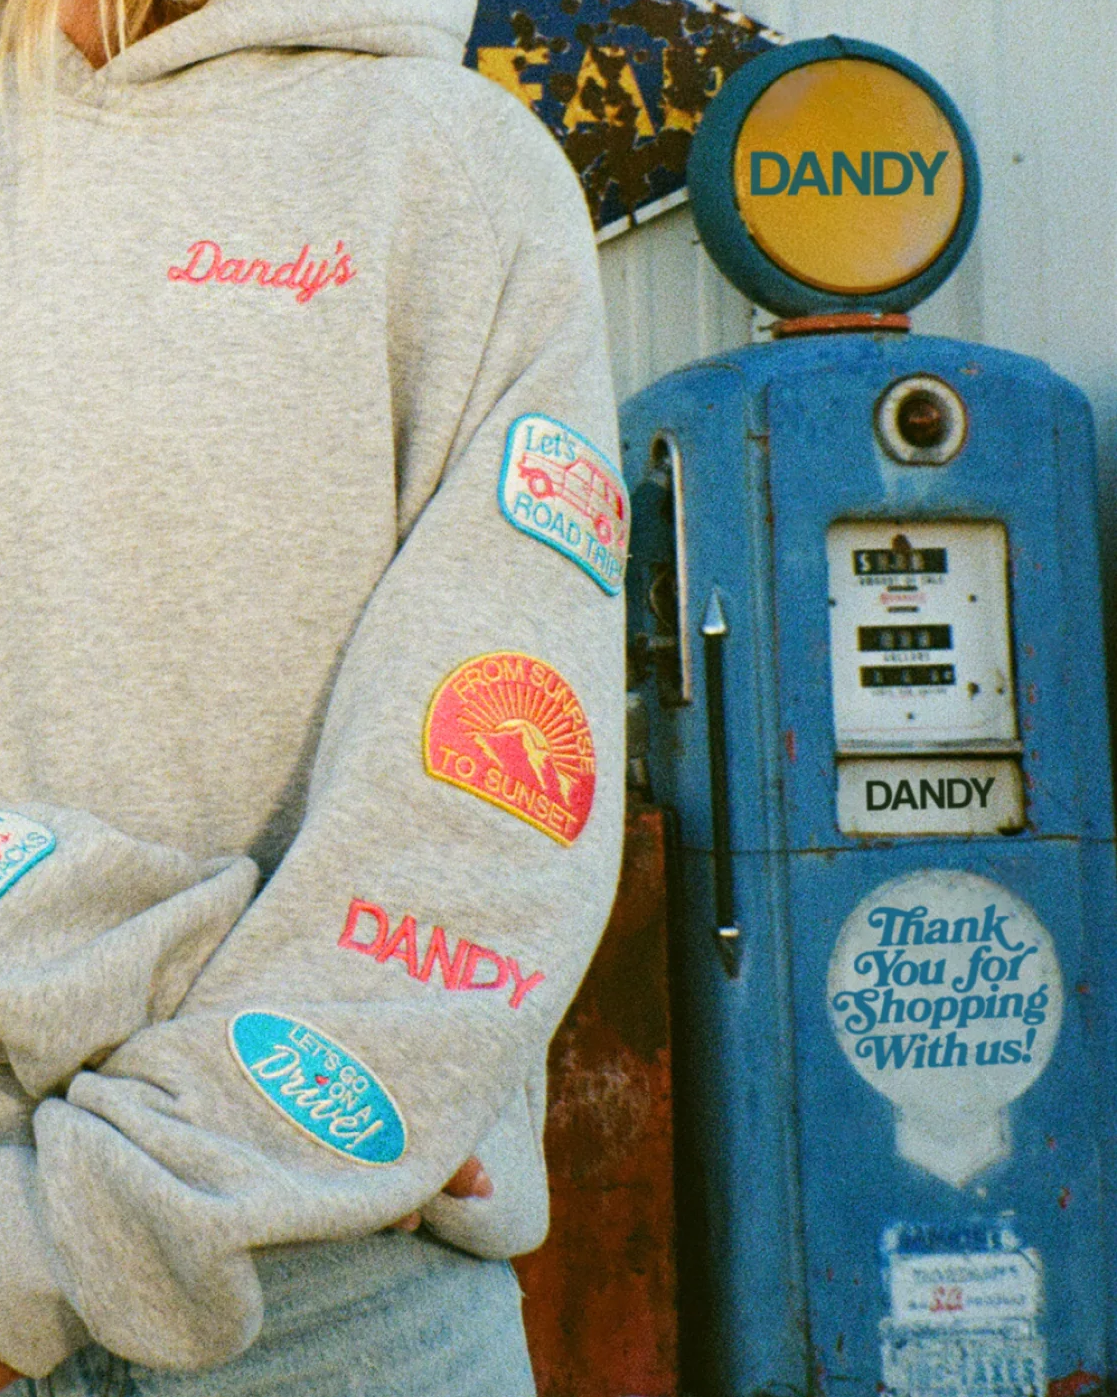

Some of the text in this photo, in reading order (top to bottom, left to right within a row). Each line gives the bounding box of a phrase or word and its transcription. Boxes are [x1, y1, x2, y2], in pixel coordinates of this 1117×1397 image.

[749, 150, 950, 197] DANDY
[167, 239, 357, 304] Dandy's
[524, 425, 577, 462] Let's
[513, 490, 581, 547] ROAD
[451, 659, 596, 775] FROM SUNRISE
[439, 746, 579, 834] TO SUNSET
[865, 776, 996, 812] DANDY
[868, 903, 1025, 952] Thank
[337, 896, 546, 1009] DANDY
[854, 945, 1039, 994] You for
[832, 983, 1049, 1035] Shopping
[855, 1027, 1038, 1071] With us!
[250, 1043, 384, 1150] Drive!
[329, 1081, 372, 1123] ON A
[339, 1065, 370, 1094] GO
